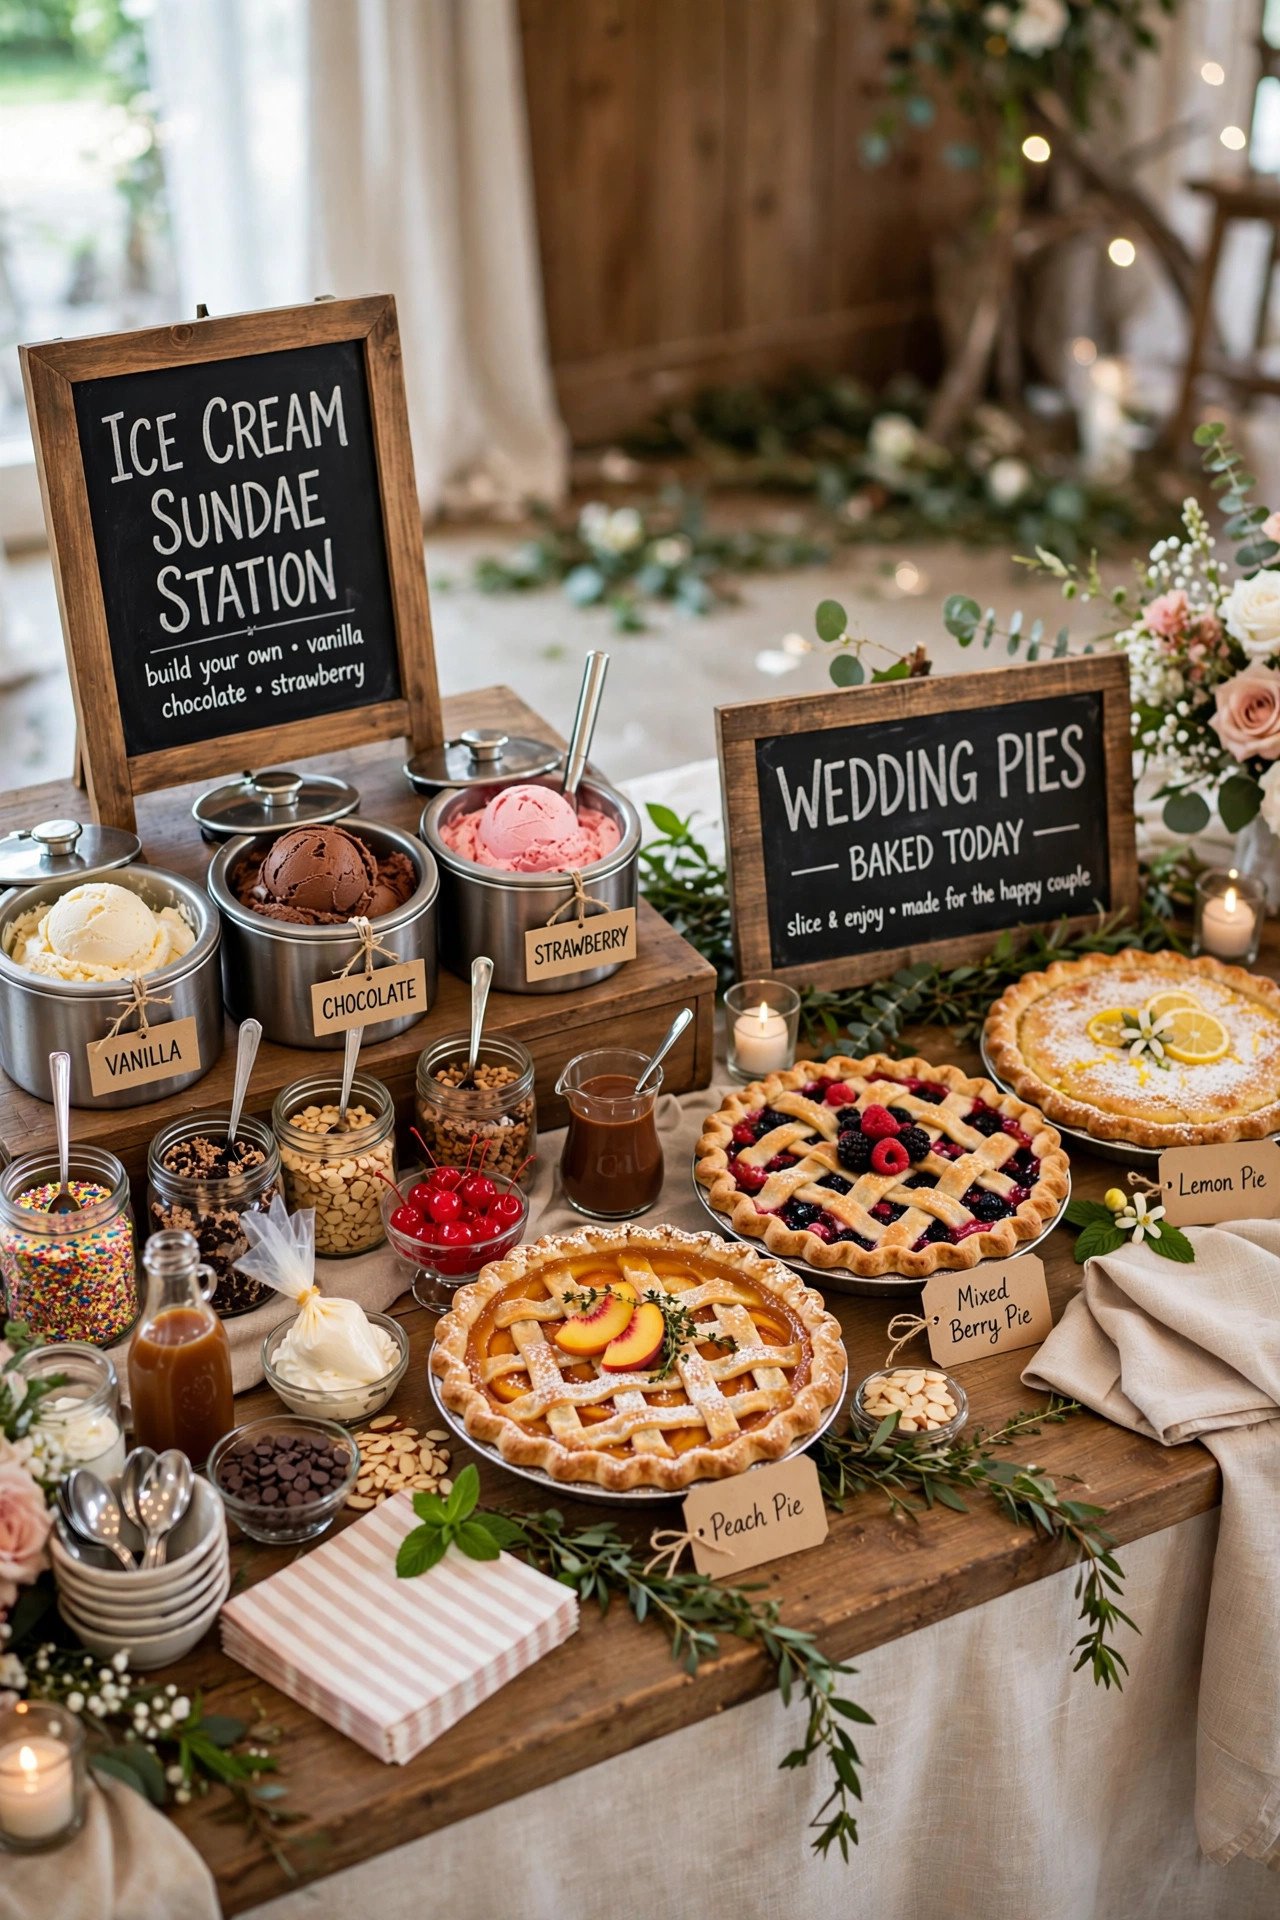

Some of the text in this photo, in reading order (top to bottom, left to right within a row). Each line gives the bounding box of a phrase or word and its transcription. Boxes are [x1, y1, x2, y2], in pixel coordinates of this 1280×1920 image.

[101, 385, 348, 484] ICE CREAM
[150, 468, 326, 555] SUNDAE
[156, 538, 337, 634] STATION
[145, 623, 363, 687] build your own vanilla
[161, 659, 365, 719] chocolate strawberry
[776, 724, 1086, 833] WEDDING PIES
[849, 819, 1023, 882] BAKED TODAY
[787, 866, 1091, 937] slice & enjoy made for the happy couple
[533, 925, 630, 966] STRAWBERRY
[322, 978, 417, 1020] CHOCOLATE
[105, 1039, 183, 1077] VANILLA
[1178, 1166, 1267, 1197] Lemon Pie
[950, 1303, 1033, 1344] Berry Pie
[957, 1277, 1010, 1311] Mixed
[710, 1492, 804, 1540] Peach Pie
